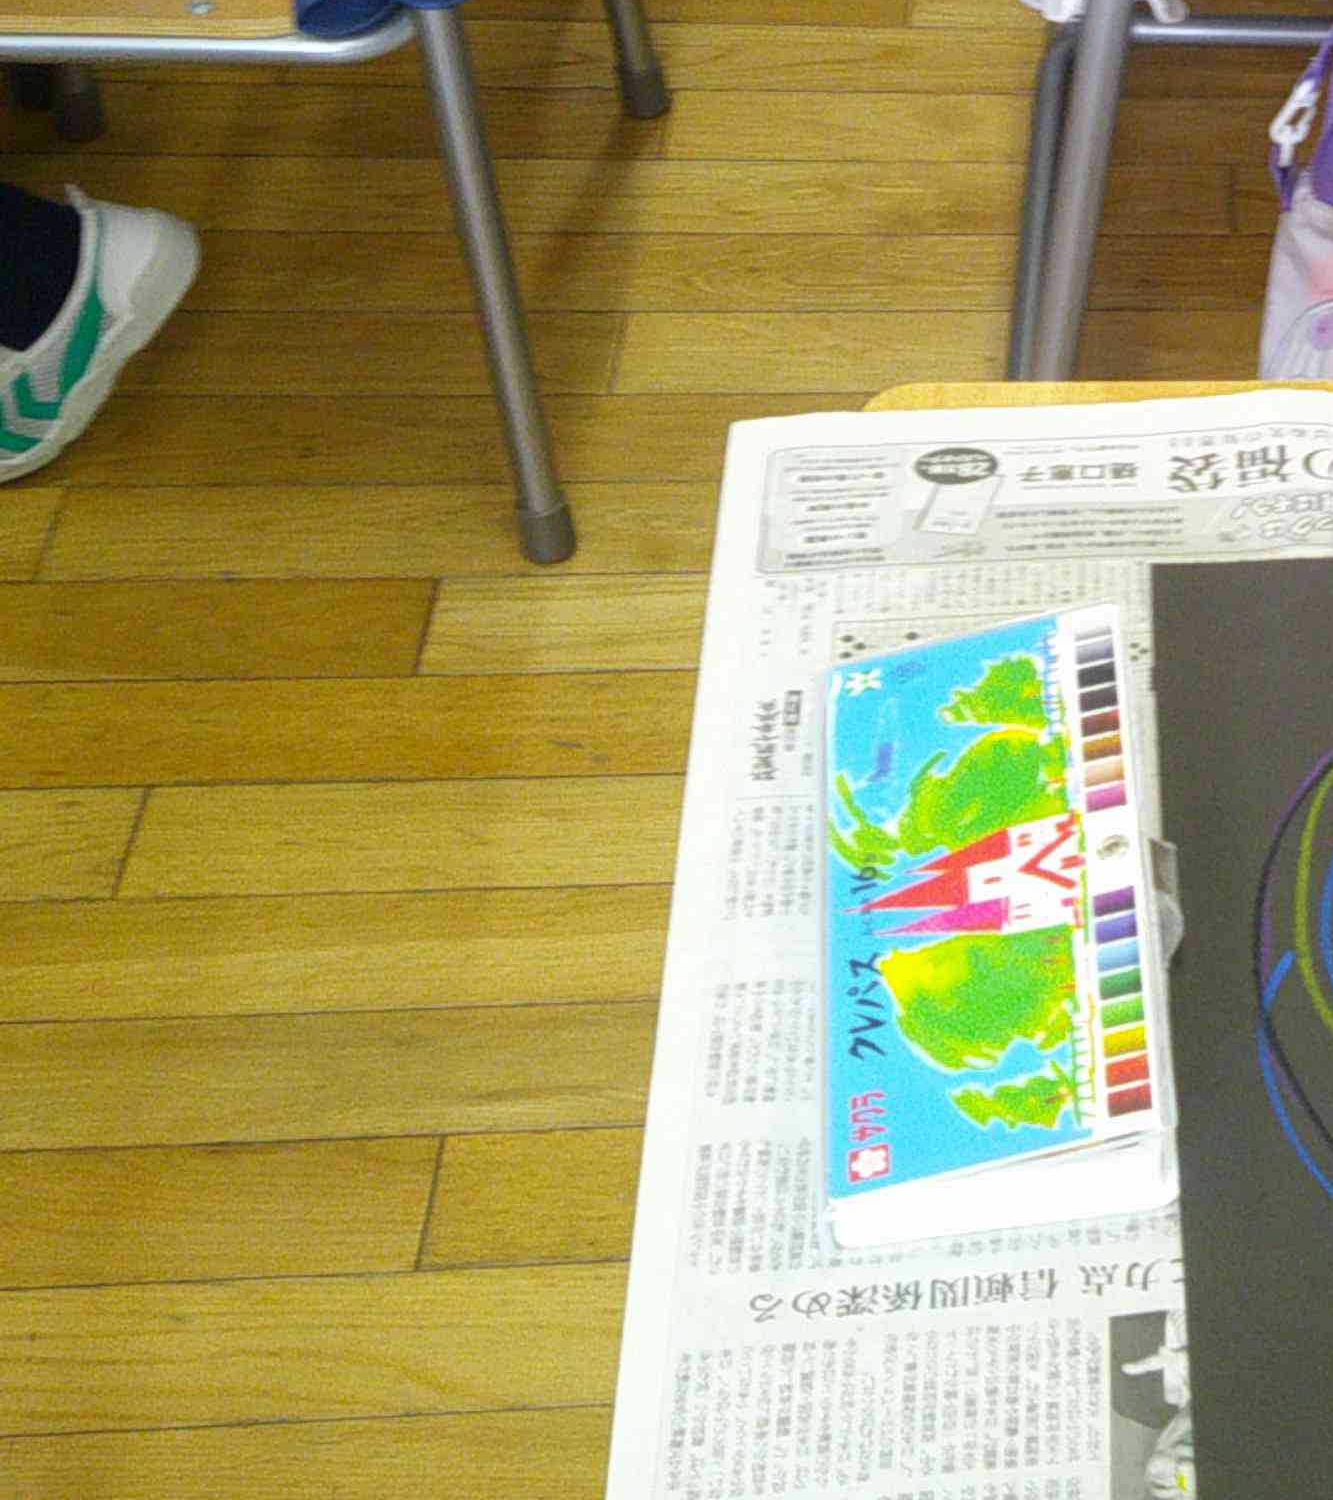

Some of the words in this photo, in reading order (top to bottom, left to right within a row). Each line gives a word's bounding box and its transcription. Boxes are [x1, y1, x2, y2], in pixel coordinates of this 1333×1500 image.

[848, 952, 887, 1060] クレパス
[850, 1091, 887, 1143] サクラ
[748, 1267, 1057, 1324] 信頼関係深める
